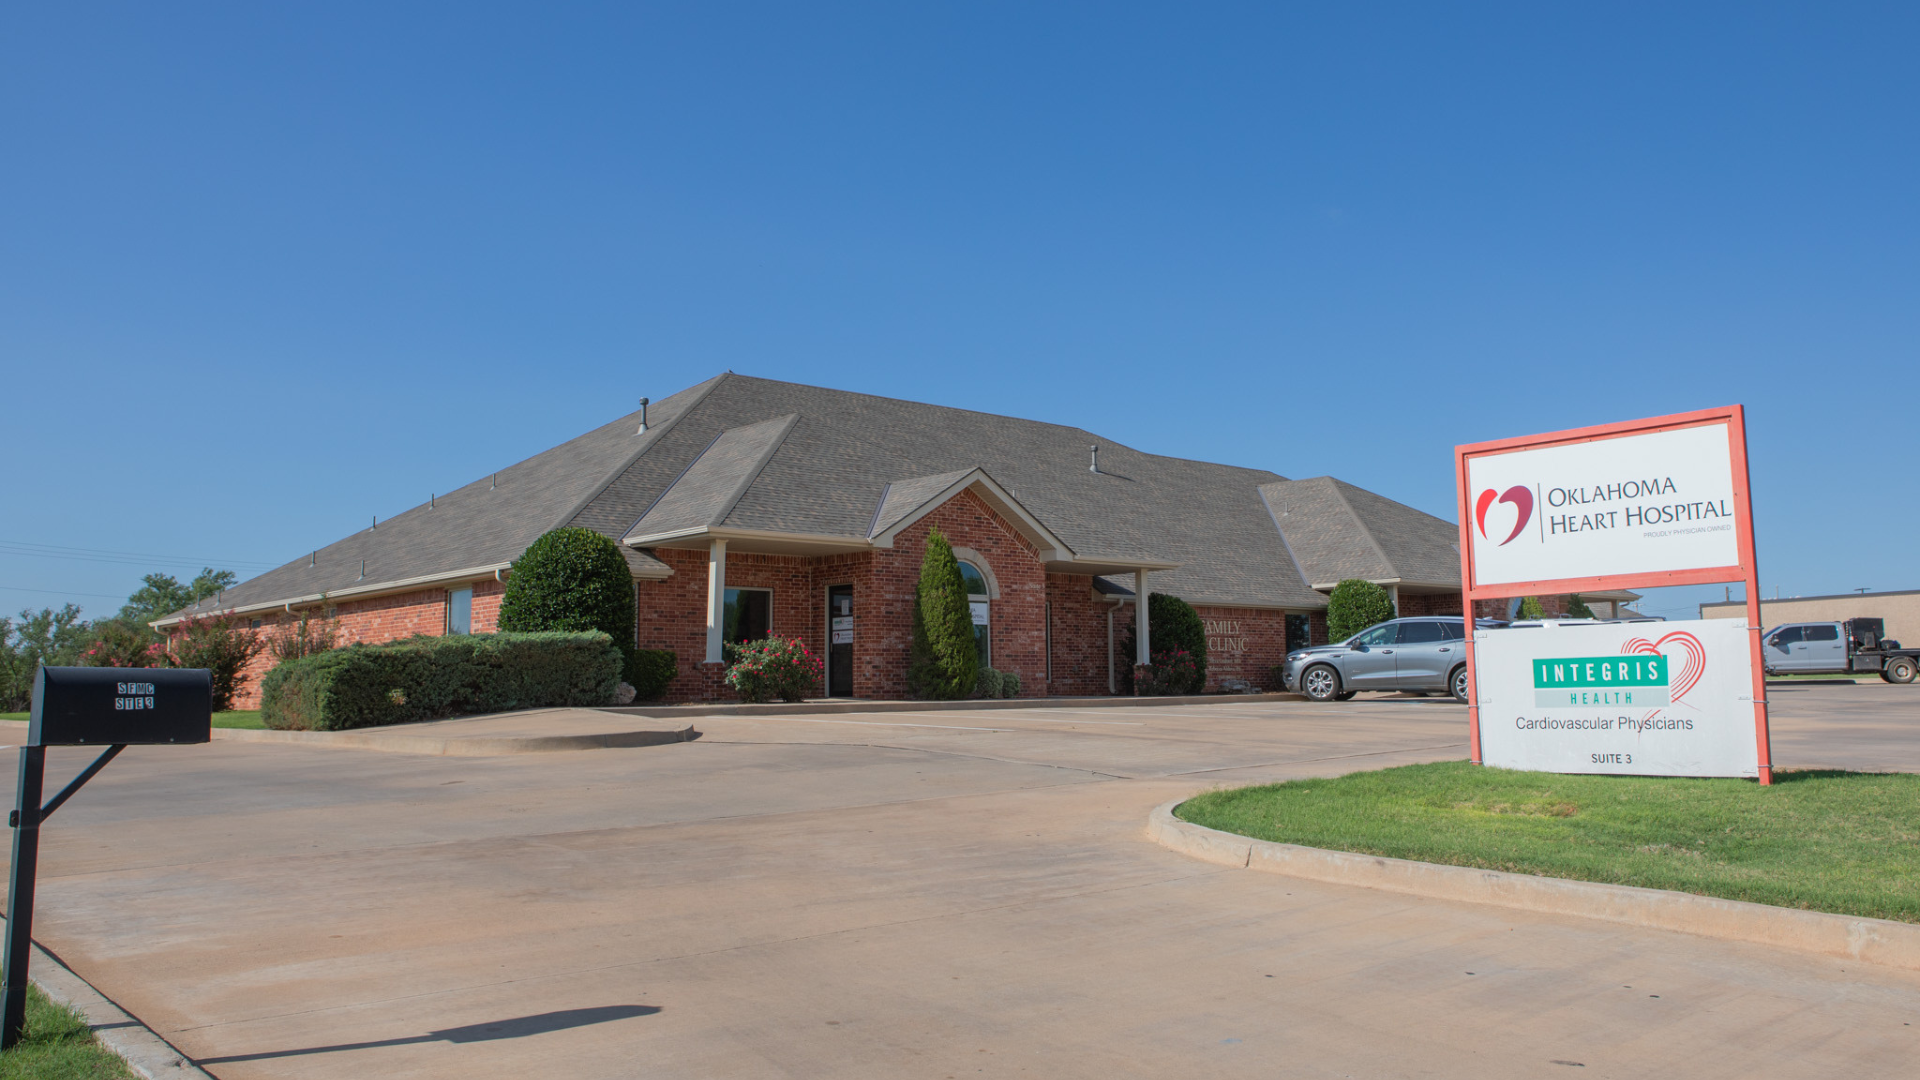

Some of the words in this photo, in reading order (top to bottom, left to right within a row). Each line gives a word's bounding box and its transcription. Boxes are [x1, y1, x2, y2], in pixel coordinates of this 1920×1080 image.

[1548, 477, 1677, 507] OKLAHOMA
[1550, 511, 1618, 535] HEART
[1625, 500, 1732, 527] HOSPITAL
[1643, 530, 1673, 538] PROUDLY
[1673, 527, 1707, 536] PHYSICIAN
[1707, 524, 1731, 532] OWNED
[1202, 620, 1241, 634] AMILY
[1208, 637, 1249, 651] CLINIC
[1542, 661, 1658, 682] INTEGRIS
[118, 682, 155, 695] SFMC
[1570, 692, 1632, 705] HEALTH
[1515, 717, 1614, 730] Cardiovascular
[1618, 716, 1694, 733] Physicians
[1591, 754, 1622, 764] SUITE
[1625, 754, 1632, 764] 3
